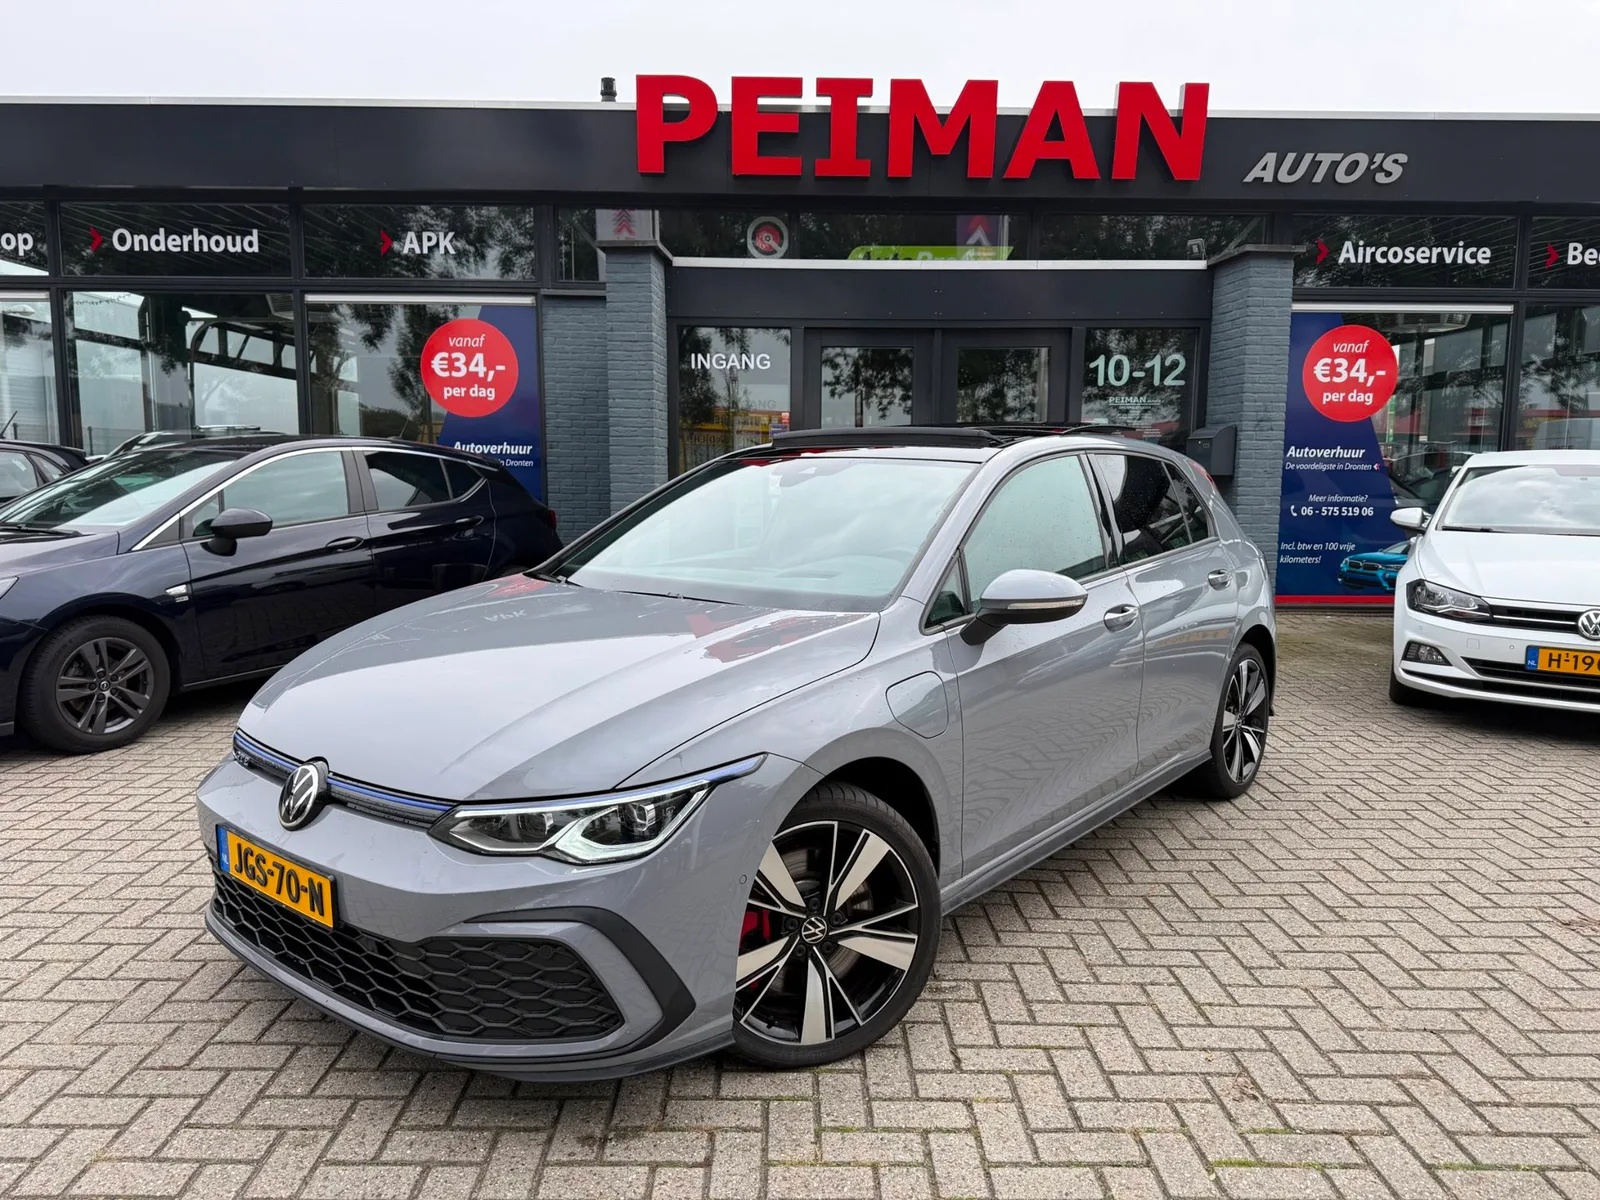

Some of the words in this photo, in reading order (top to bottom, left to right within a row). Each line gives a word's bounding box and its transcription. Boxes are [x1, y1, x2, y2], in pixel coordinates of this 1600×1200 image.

[636, 74, 1210, 181] PEIMAN
[1242, 152, 1409, 184] AUTO'S
[0, 232, 34, 256] op
[112, 227, 260, 253] Onderhoud
[402, 230, 456, 255] APK
[1337, 240, 1492, 265] Aircoservice
[448, 333, 486, 348] vanaf
[1332, 339, 1370, 354] vanaf
[430, 351, 506, 382] €34,-
[690, 352, 771, 370] INGANG
[1088, 354, 1186, 387] 10-12
[1313, 357, 1387, 387] €34,-
[443, 385, 466, 400] per
[469, 383, 496, 400] dag
[1322, 390, 1345, 405] per
[1347, 389, 1374, 405] dag
[453, 441, 533, 455] Autoverhuur
[1286, 445, 1366, 458] Autoverhuur
[505, 459, 534, 467] Dronten
[1285, 462, 1295, 470] De
[1296, 462, 1336, 471] voordeligste
[1336, 462, 1344, 470] in
[1344, 462, 1372, 471] Dronten
[1308, 494, 1326, 502] Meer
[1327, 494, 1369, 503] informatie?
[1301, 506, 1313, 516] 06
[1321, 506, 1341, 516] 575
[1341, 507, 1360, 516] 519
[1361, 507, 1374, 517] 06
[1280, 542, 1296, 550] Incl.
[1297, 541, 1313, 551] btw
[1325, 542, 1338, 551] 100
[1339, 543, 1356, 552] vrije
[1279, 555, 1322, 564] kilometers!
[1527, 659, 1537, 667] NL
[234, 842, 325, 917] JGS-70-N
